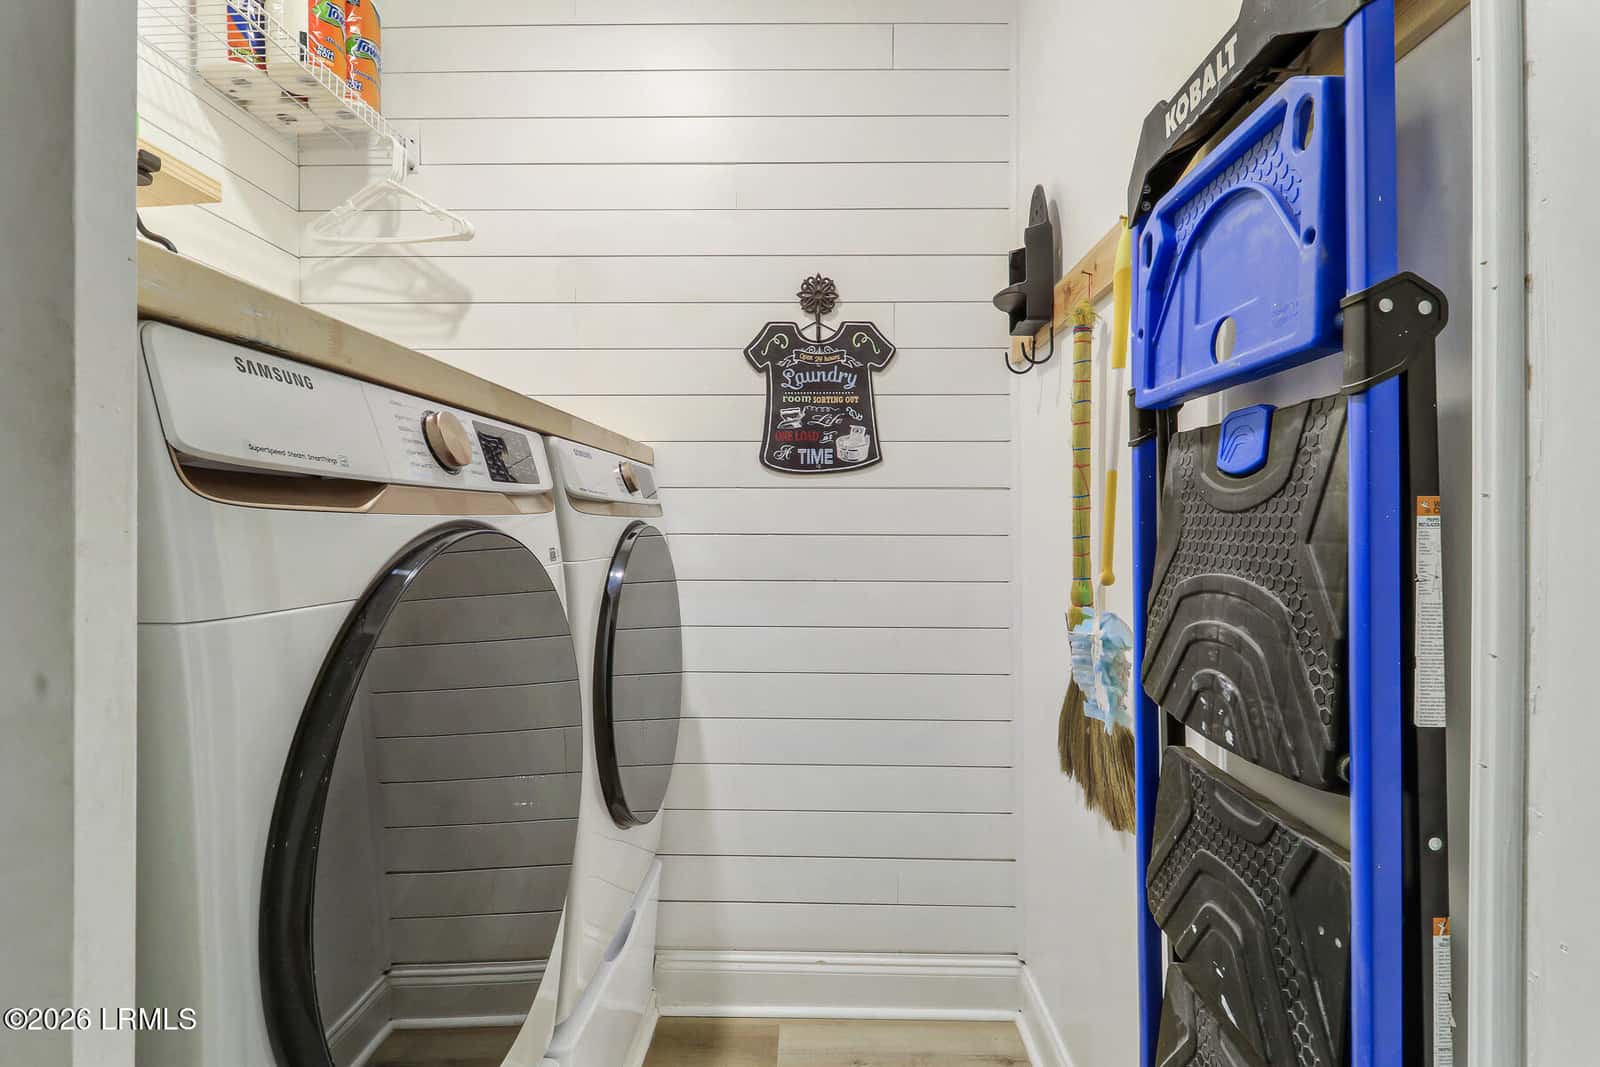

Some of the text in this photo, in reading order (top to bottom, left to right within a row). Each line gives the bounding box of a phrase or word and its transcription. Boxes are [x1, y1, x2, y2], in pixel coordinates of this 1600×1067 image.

[1165, 33, 1238, 139] KOBALT
[233, 356, 314, 390] SAMSUNG
[781, 365, 857, 389] Laundry
[783, 395, 860, 403] room SORTING OUT
[807, 413, 845, 427] Life
[794, 431, 820, 441] LOAD
[797, 448, 834, 465] TIME
